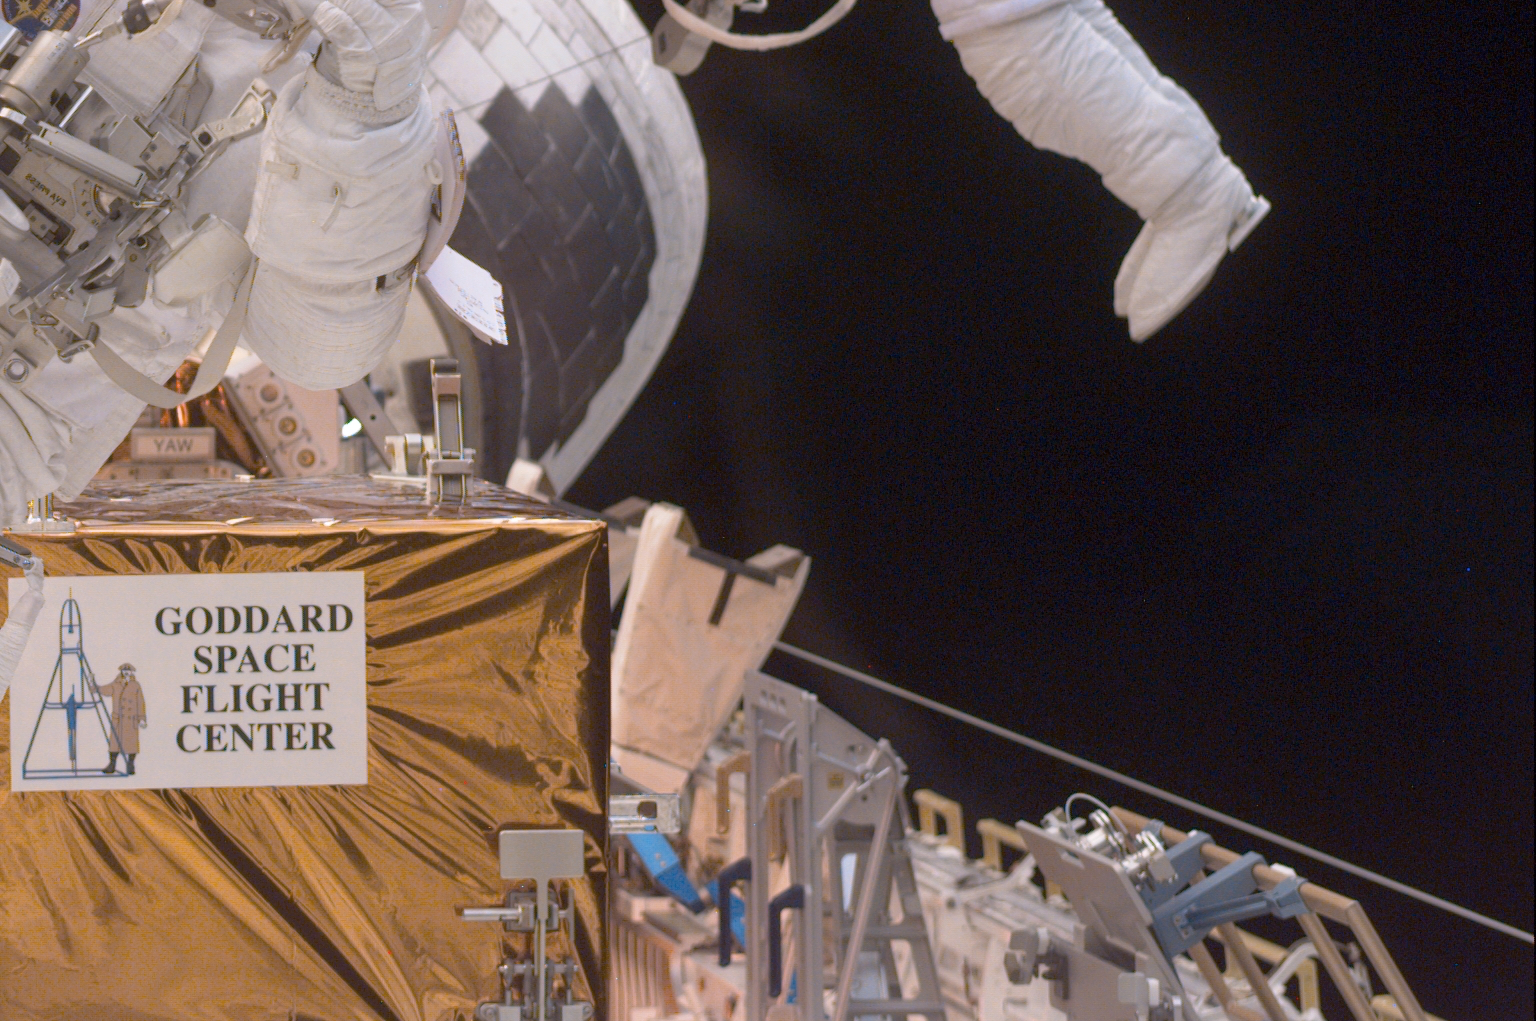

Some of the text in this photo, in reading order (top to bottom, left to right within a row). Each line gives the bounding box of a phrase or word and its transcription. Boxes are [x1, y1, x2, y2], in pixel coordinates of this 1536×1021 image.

[153, 438, 194, 452] YAW
[154, 604, 354, 636] GODDARD
[193, 643, 316, 674] SPACE
[180, 683, 330, 714] FLIGHT
[176, 722, 336, 754] CENTER
